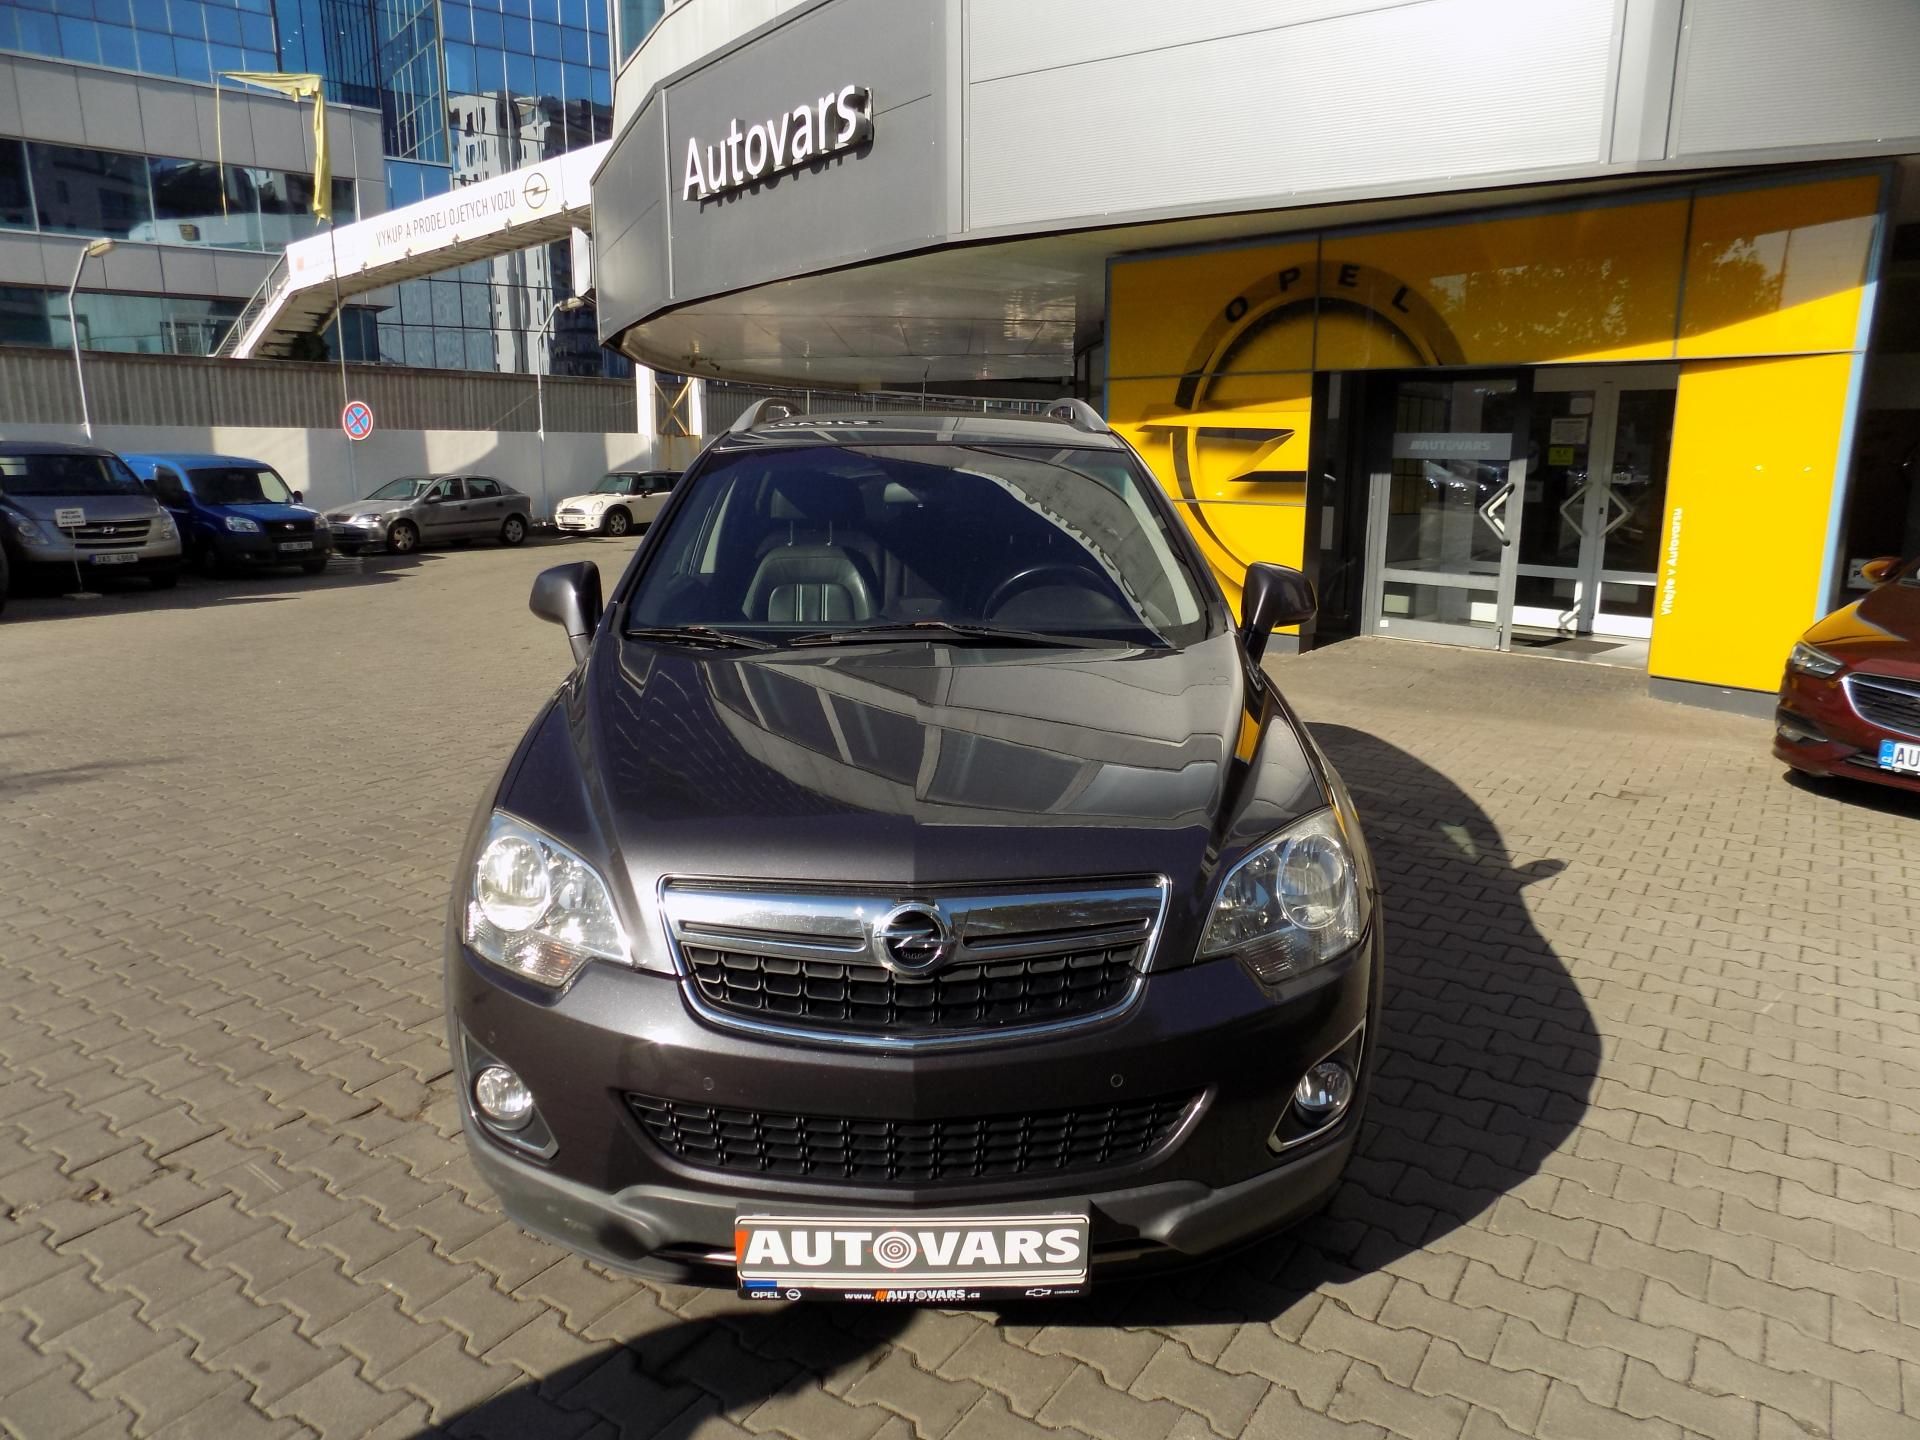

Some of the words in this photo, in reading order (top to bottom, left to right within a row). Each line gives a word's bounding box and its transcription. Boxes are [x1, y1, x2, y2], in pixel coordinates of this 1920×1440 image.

[682, 83, 861, 201] Autovars
[406, 222, 413, 239] A
[413, 212, 447, 238] PRODEJ
[1224, 262, 1411, 324] OPEL
[744, 1228, 1081, 1268] AUTOVARS
[750, 1291, 782, 1299] OPEL
